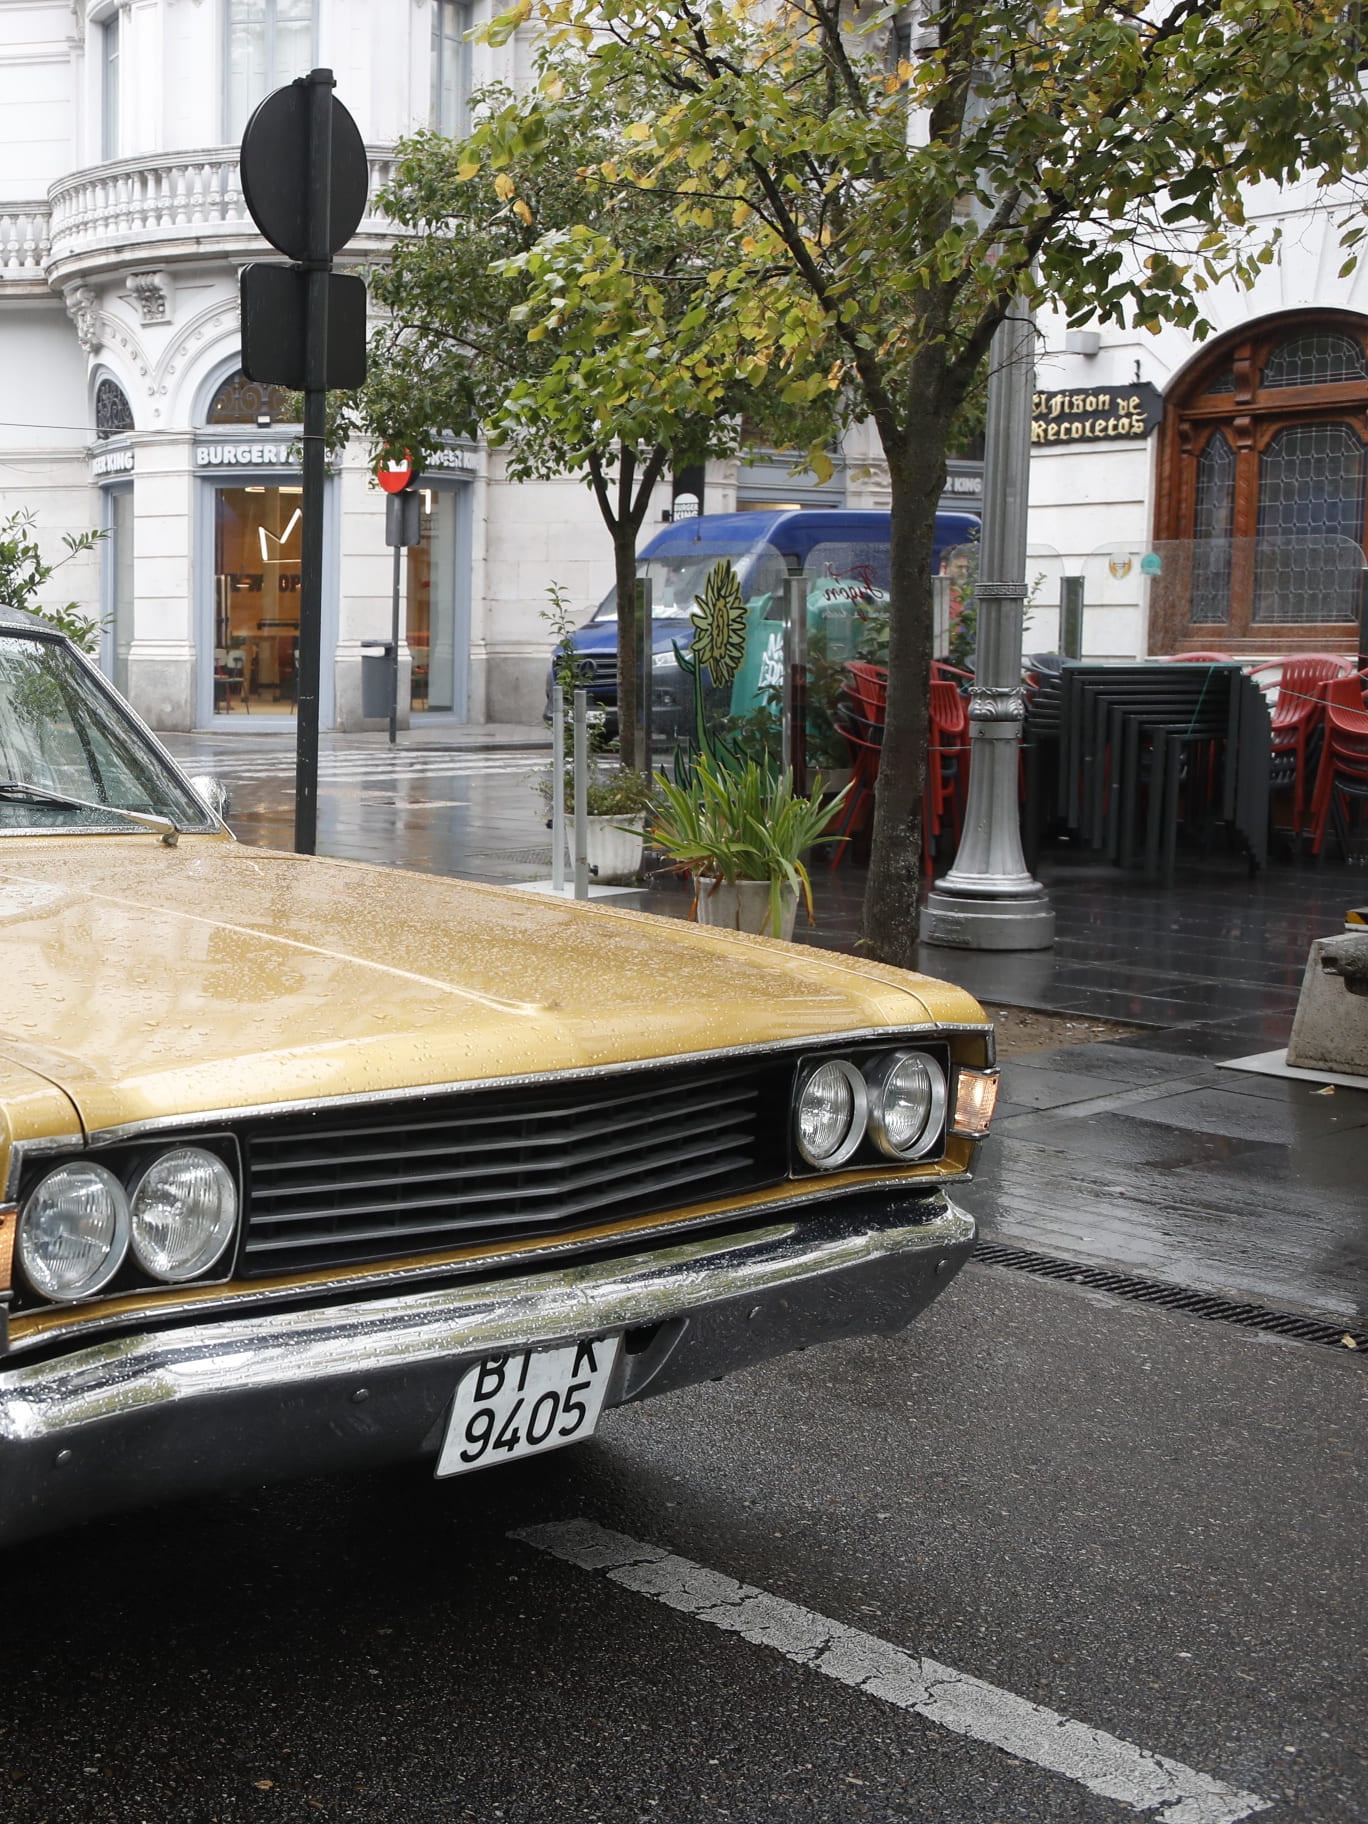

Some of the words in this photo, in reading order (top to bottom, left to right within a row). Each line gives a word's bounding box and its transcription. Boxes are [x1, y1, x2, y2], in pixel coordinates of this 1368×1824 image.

[107, 451, 133, 471] KING
[196, 446, 277, 466] BURGER
[953, 477, 982, 492] KING
[459, 1380, 592, 1463] 9405
